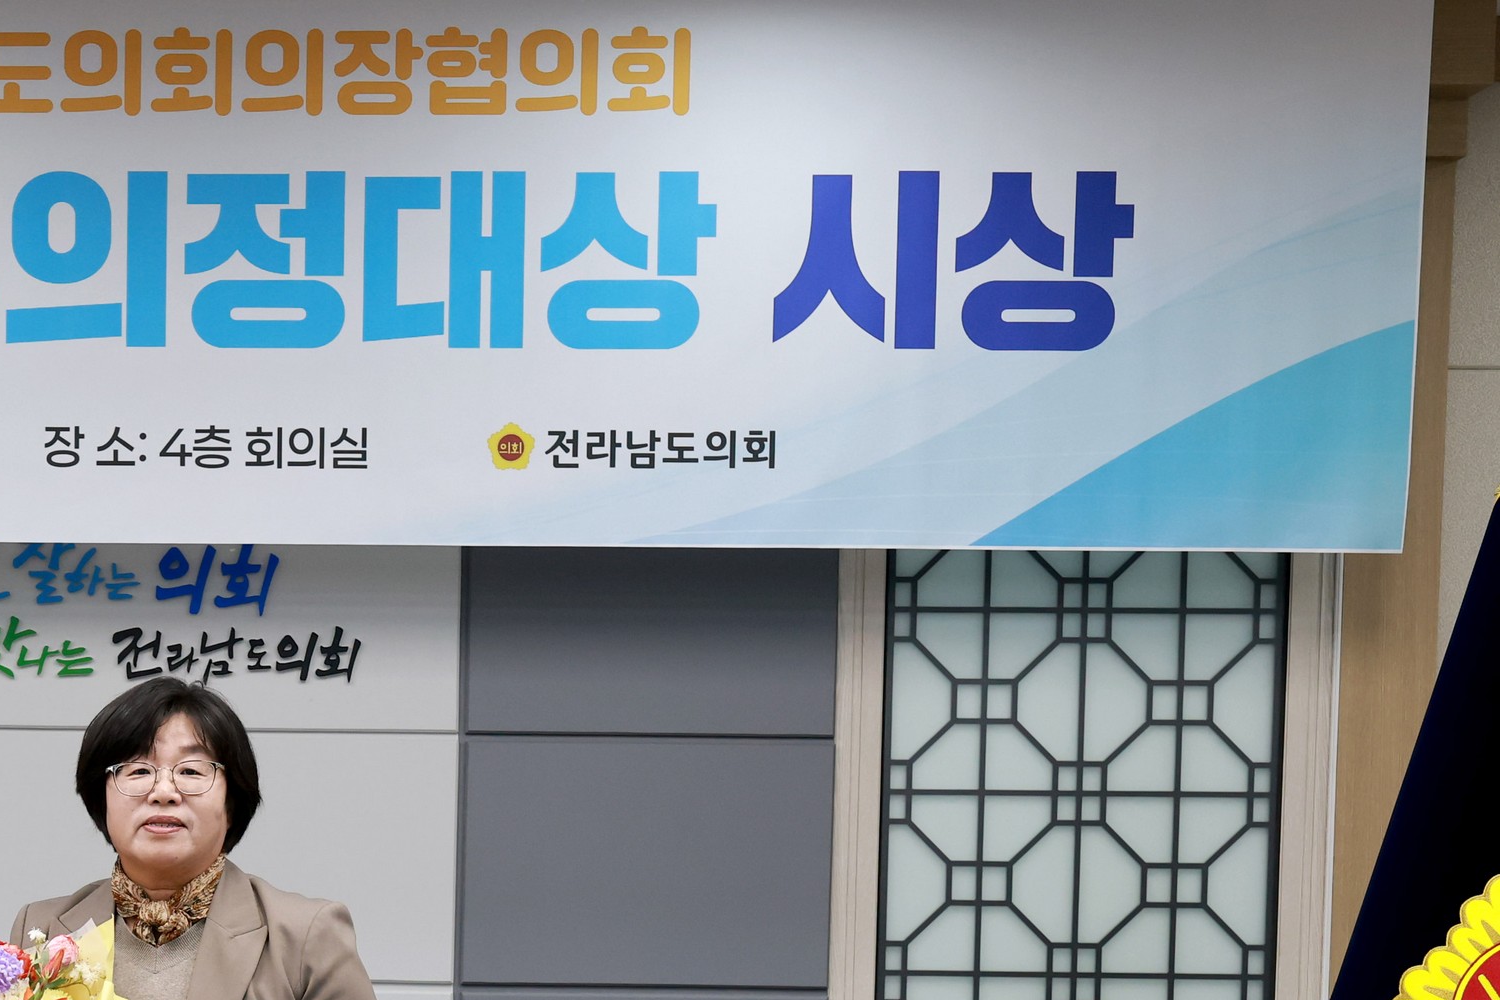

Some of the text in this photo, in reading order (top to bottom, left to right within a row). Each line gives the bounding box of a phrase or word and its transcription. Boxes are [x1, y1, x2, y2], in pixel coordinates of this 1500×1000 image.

[773, 170, 1135, 351] 시상
[159, 424, 232, 469] 4층
[245, 426, 368, 470] 회의실
[499, 441, 522, 454] 의회
[544, 429, 776, 469] 전라남도의회
[155, 544, 279, 616] 의회
[112, 626, 361, 685] 전라남도의회
